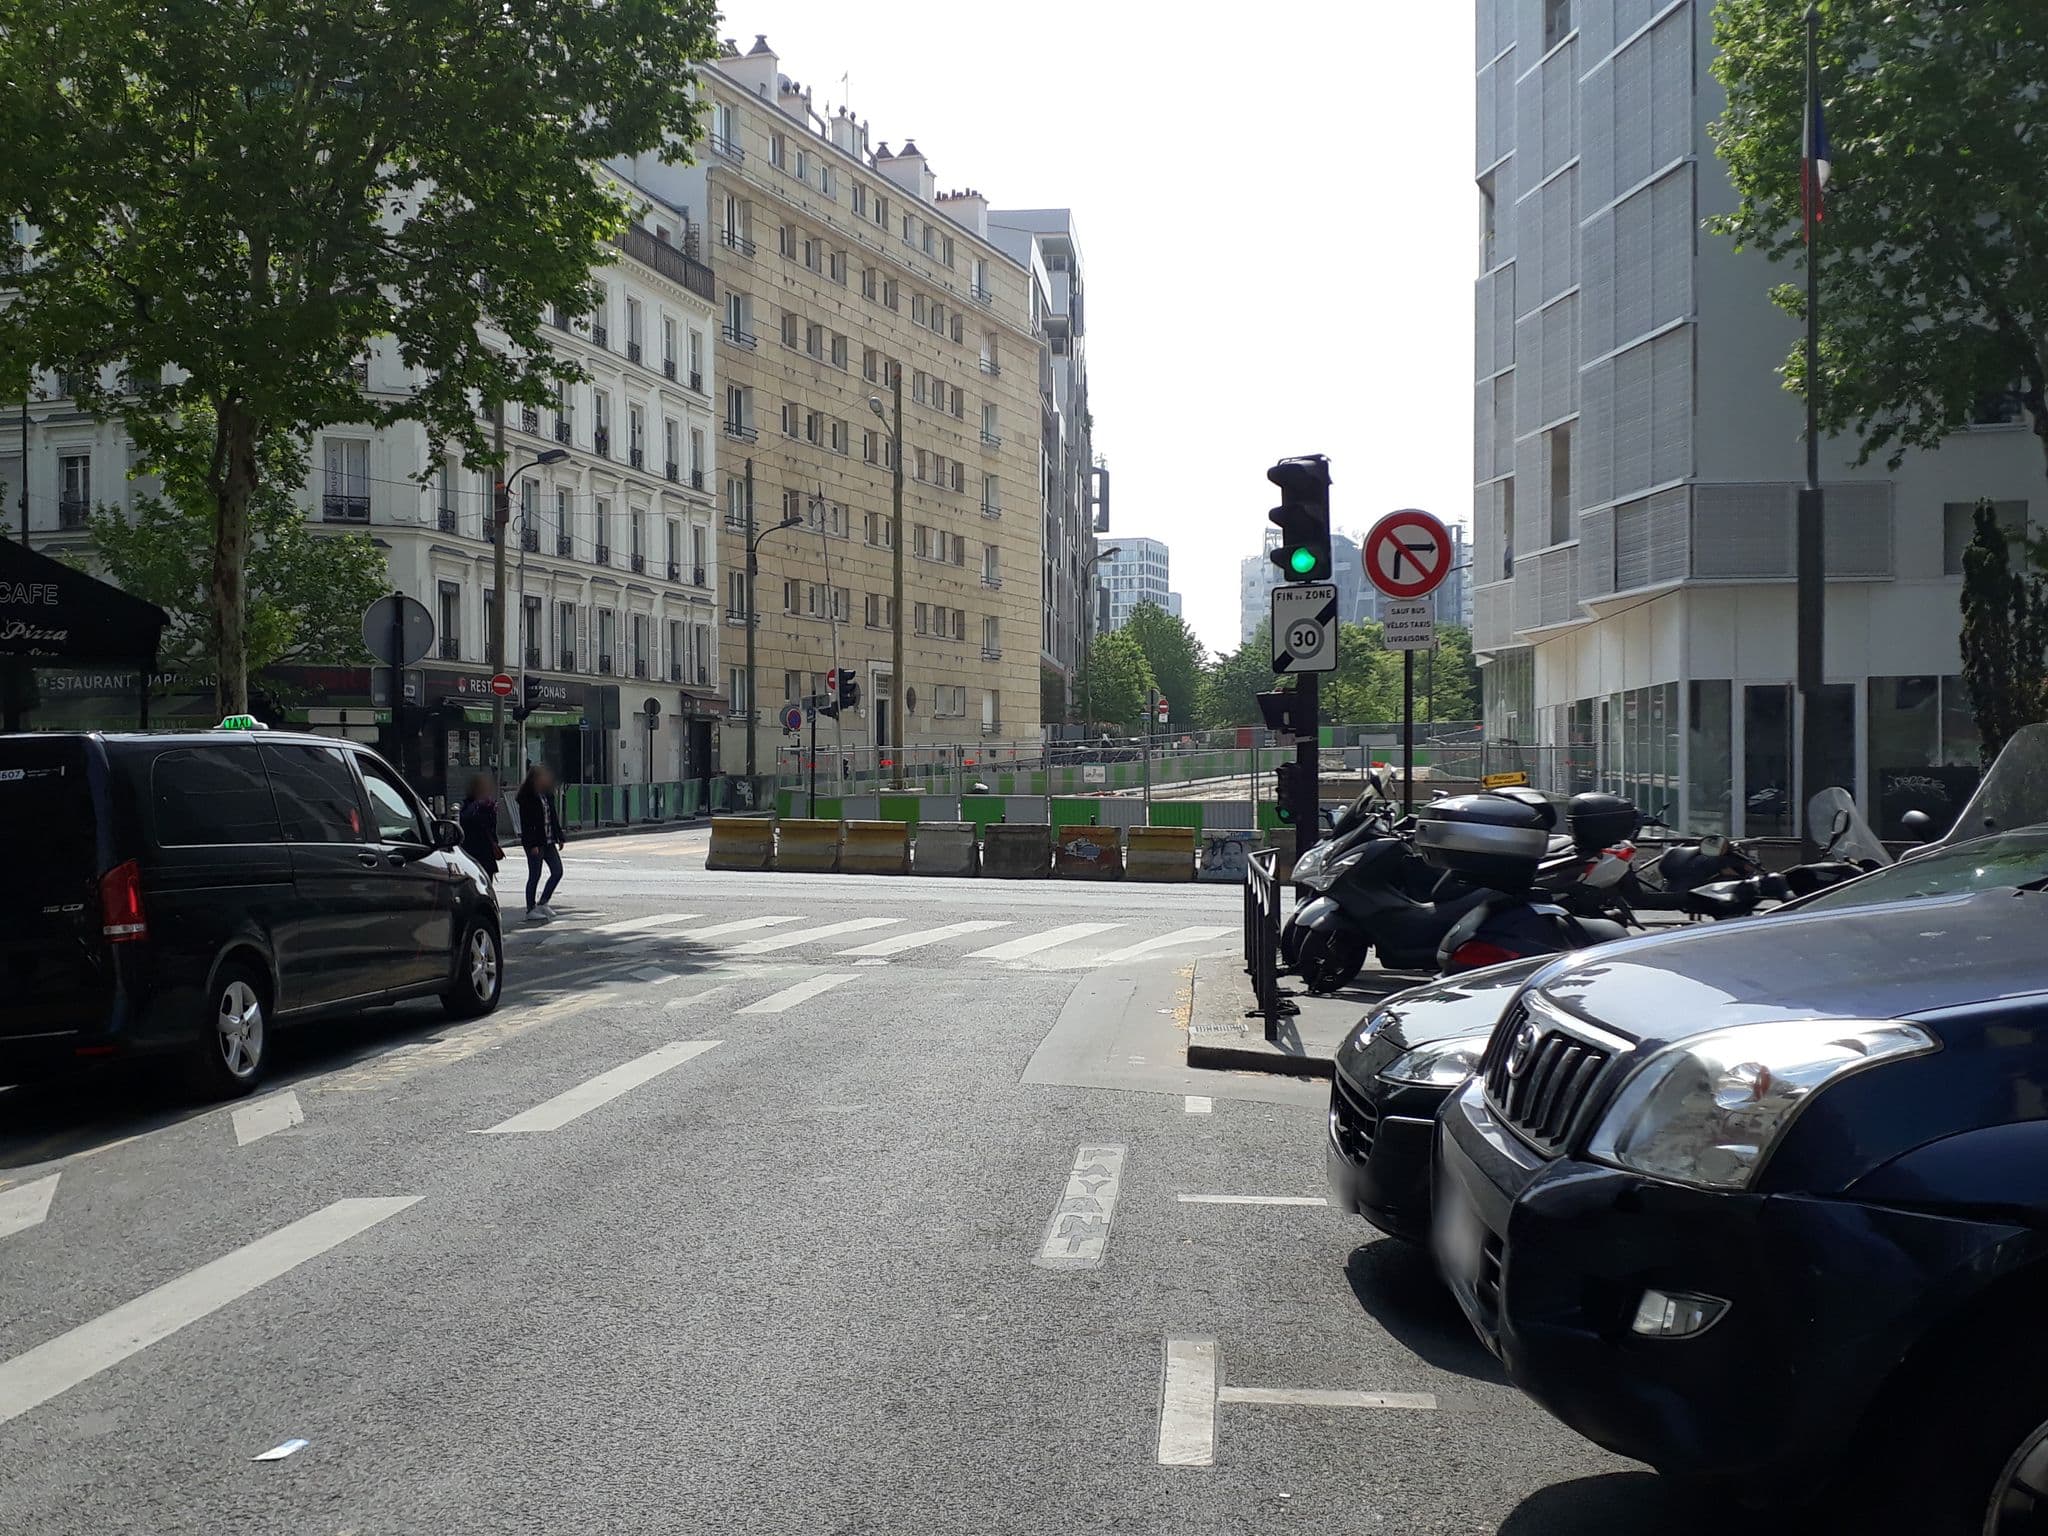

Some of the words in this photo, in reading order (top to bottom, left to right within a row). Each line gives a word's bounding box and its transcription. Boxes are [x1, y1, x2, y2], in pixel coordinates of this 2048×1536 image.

[0, 582, 59, 605] CAFE
[1276, 592, 1293, 601] FIN
[1305, 590, 1332, 600] ZONE
[1391, 607, 1410, 615] SAUF
[1411, 607, 1426, 615] BUS
[0, 619, 69, 641] Pizza
[1410, 620, 1431, 628] TAXIS
[1293, 630, 1316, 647] 30
[1387, 634, 1430, 643] LIVRAISONS
[226, 716, 249, 729] TAXI
